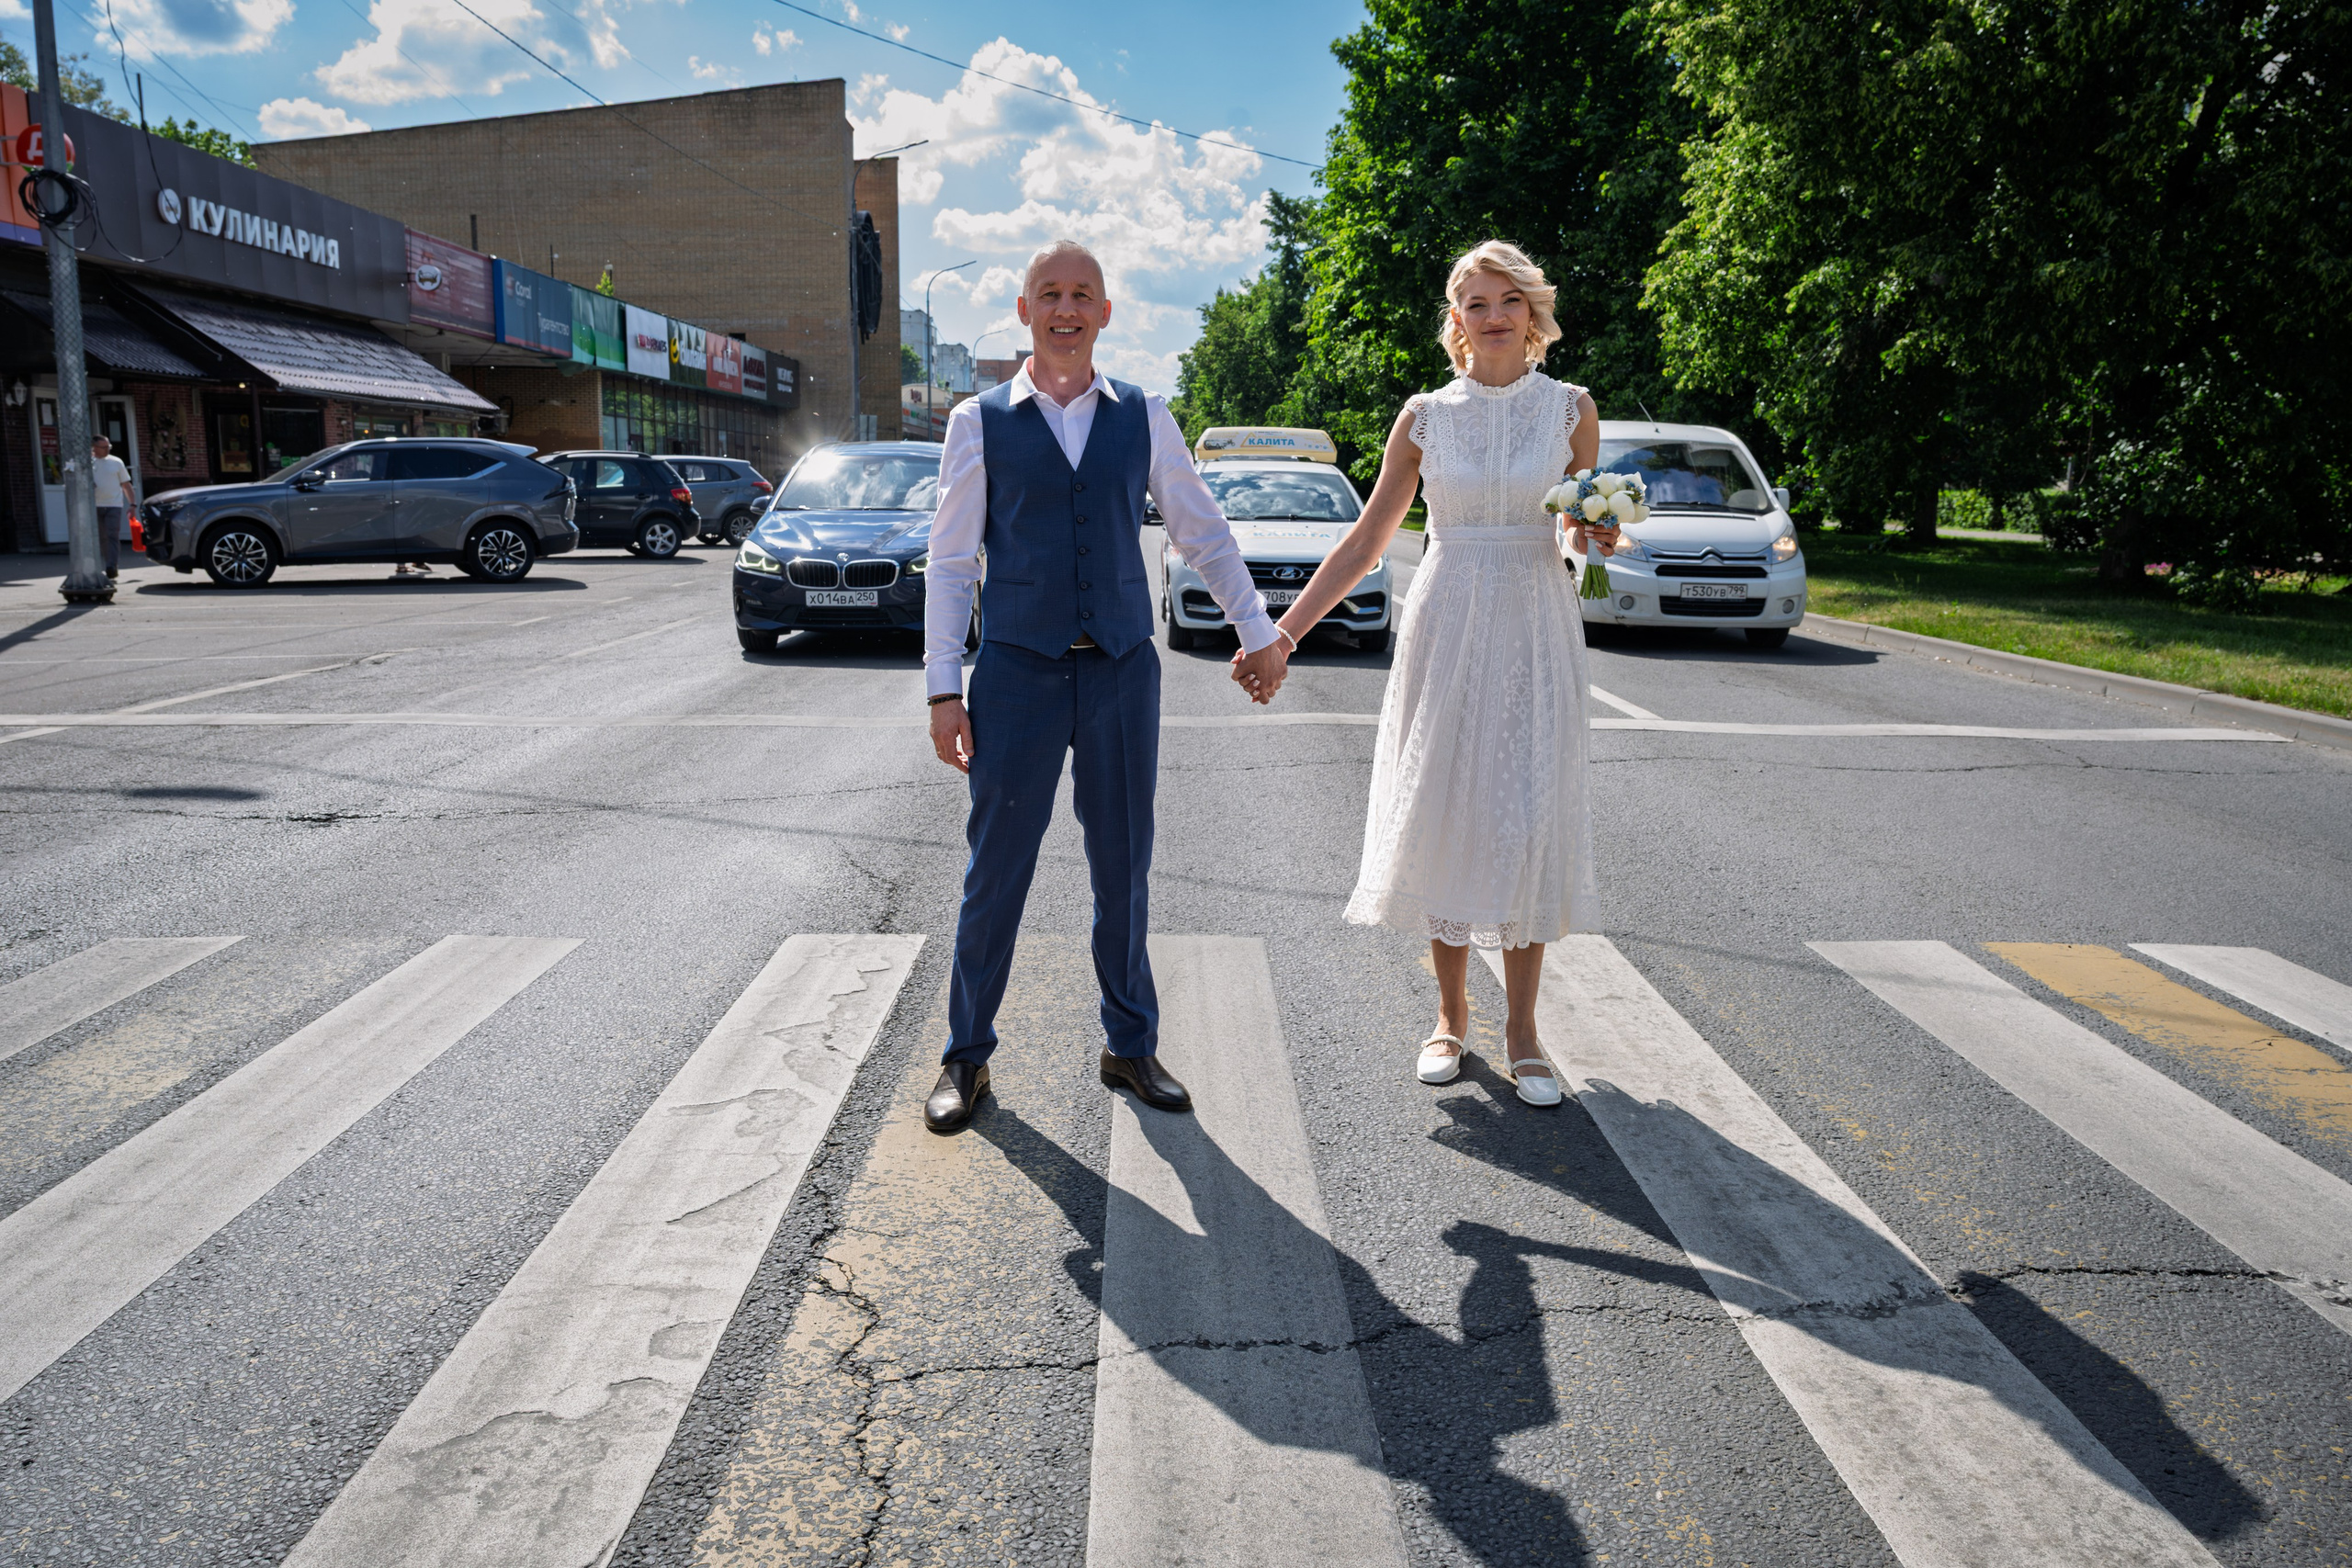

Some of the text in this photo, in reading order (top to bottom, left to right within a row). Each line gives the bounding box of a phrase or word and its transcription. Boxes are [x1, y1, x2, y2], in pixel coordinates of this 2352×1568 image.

[187, 196, 340, 269] КУЛИНАРИЯ
[1249, 437, 1295, 446] КАЛИТА
[1728, 585, 1745, 594] 799
[856, 592, 875, 602] 250
